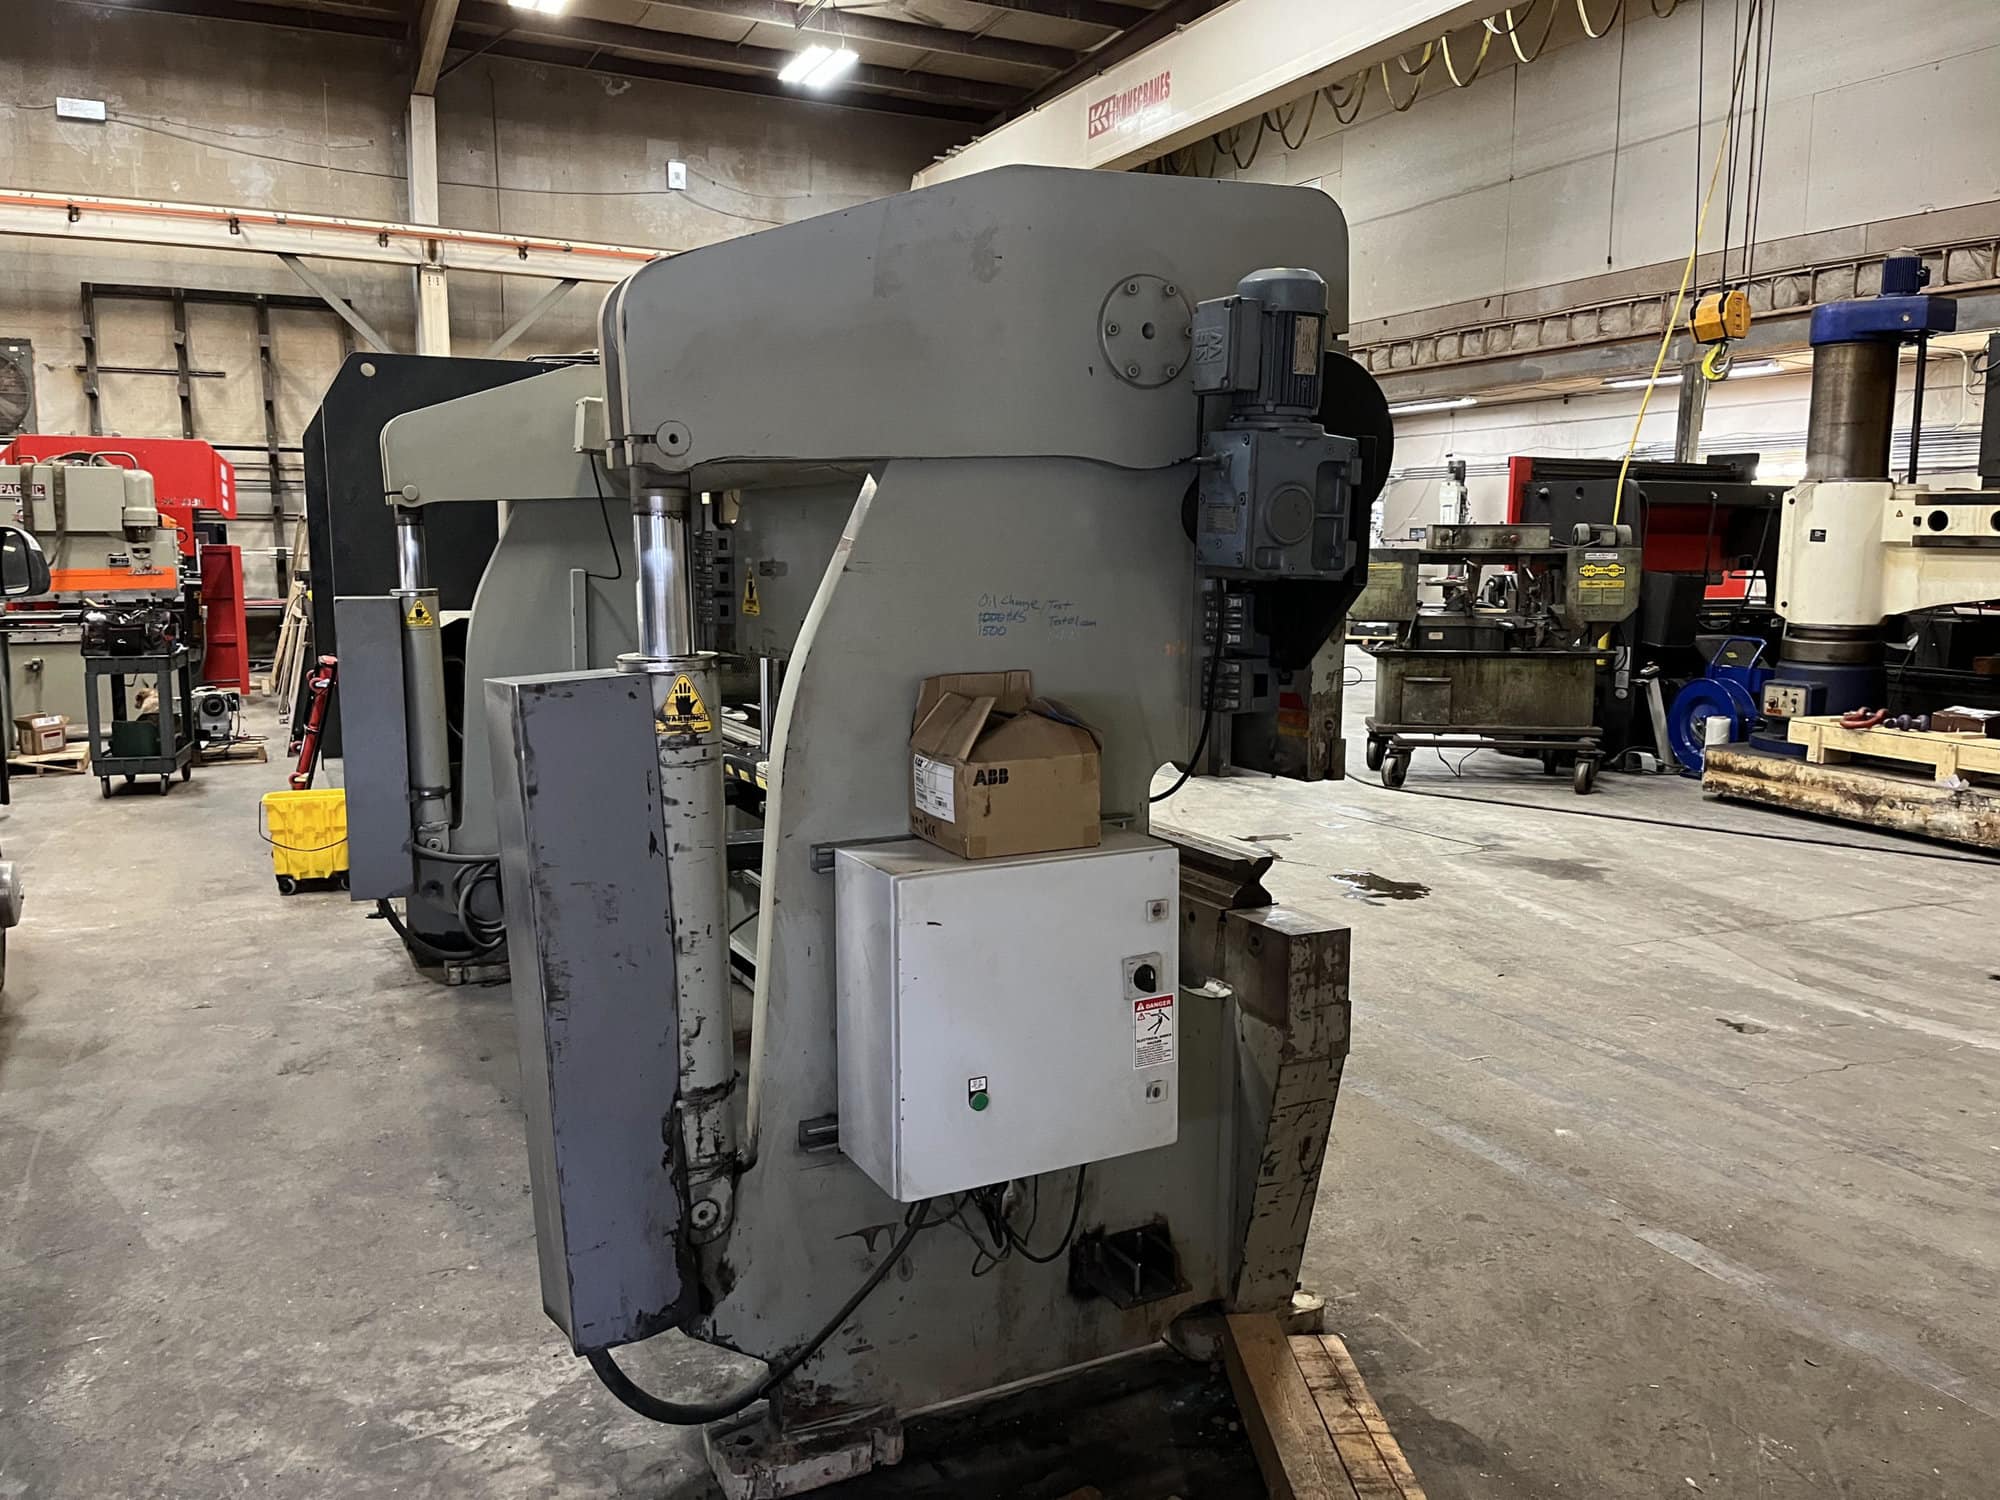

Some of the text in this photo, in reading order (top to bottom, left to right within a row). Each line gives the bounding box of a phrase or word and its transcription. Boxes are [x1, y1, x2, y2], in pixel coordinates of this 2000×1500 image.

[0, 484, 45, 495] PACIC
[978, 625, 1007, 636] 1500
[973, 768, 1009, 786] ABB
[1145, 1000, 1171, 1009] DANGER
